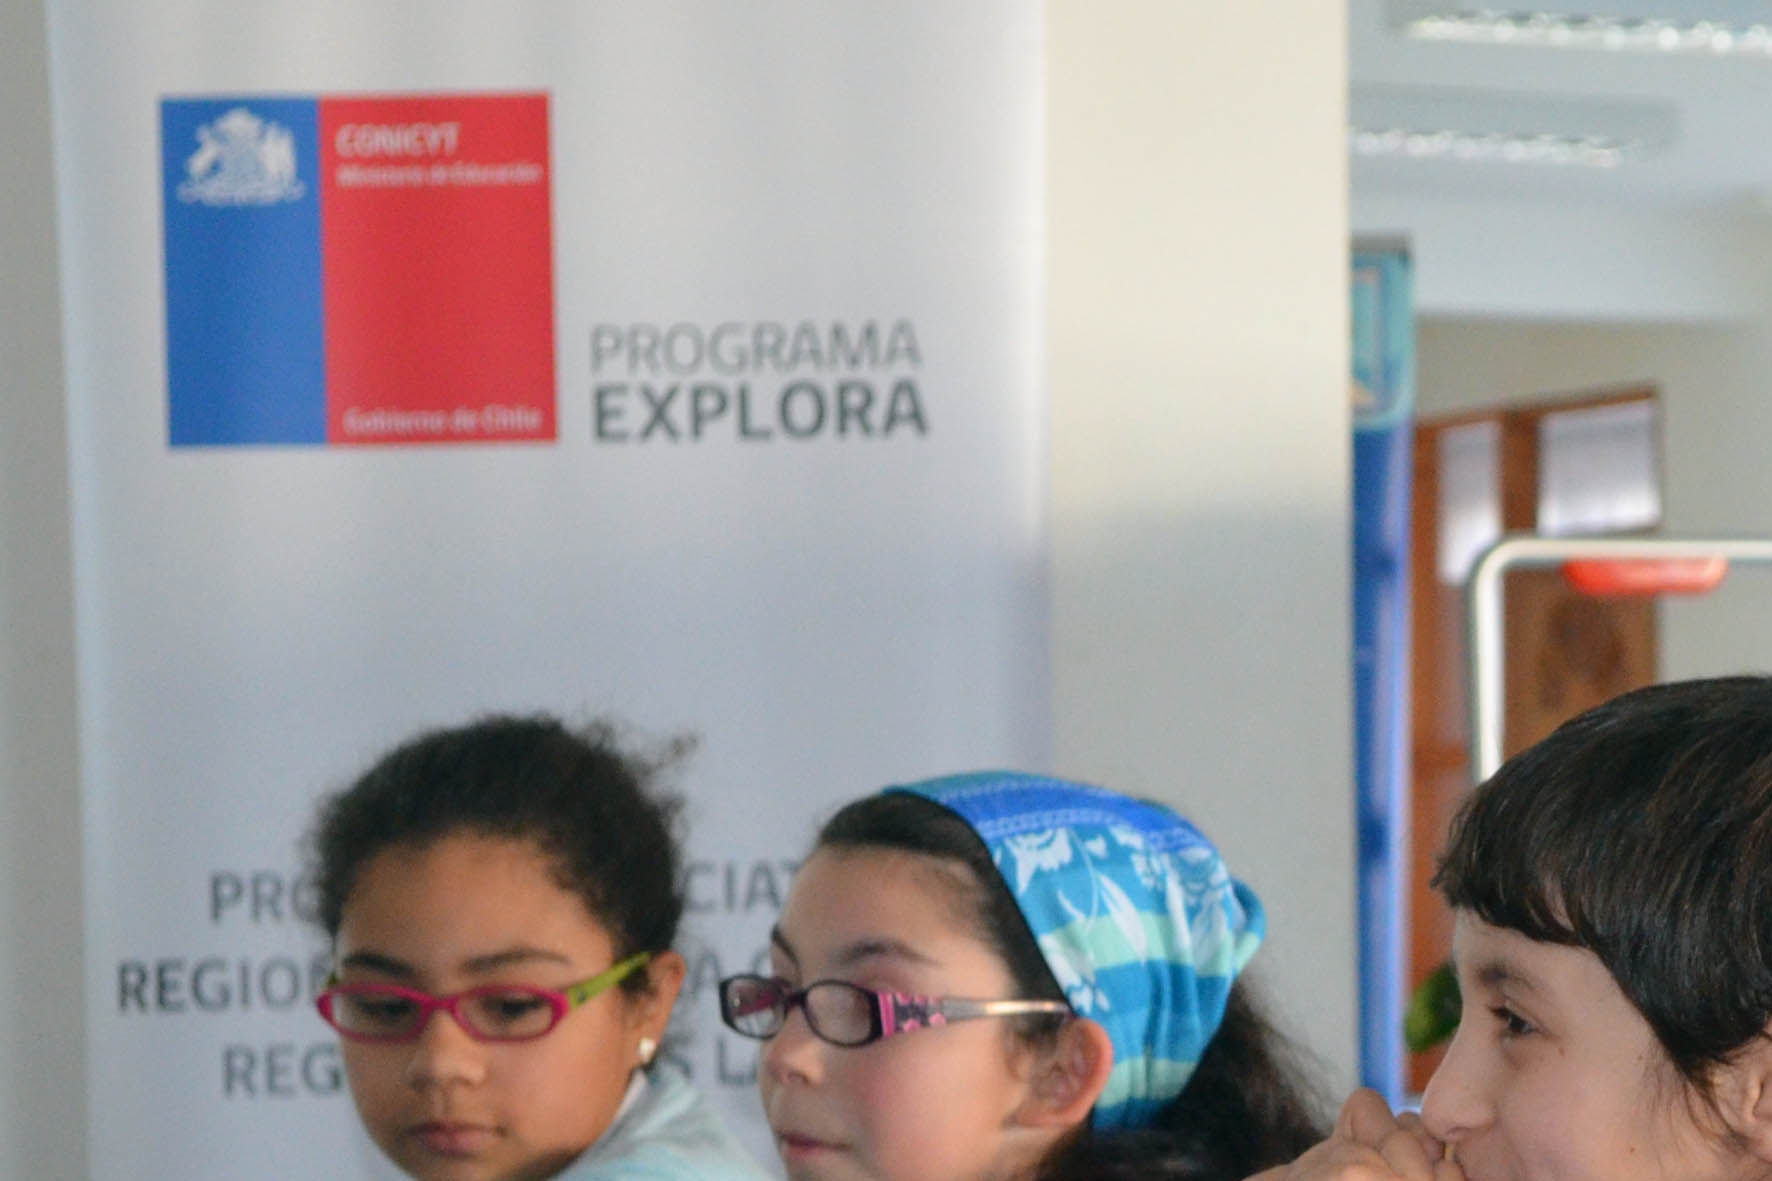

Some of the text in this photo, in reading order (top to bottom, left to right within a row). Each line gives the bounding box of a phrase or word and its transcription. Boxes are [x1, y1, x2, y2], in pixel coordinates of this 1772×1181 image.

[335, 122, 460, 158] CONICYT
[590, 318, 922, 376] PROGRAMA
[343, 403, 543, 435] Gobierno de Chile
[593, 377, 929, 444] EXPLORA
[223, 1043, 342, 1098] REG
